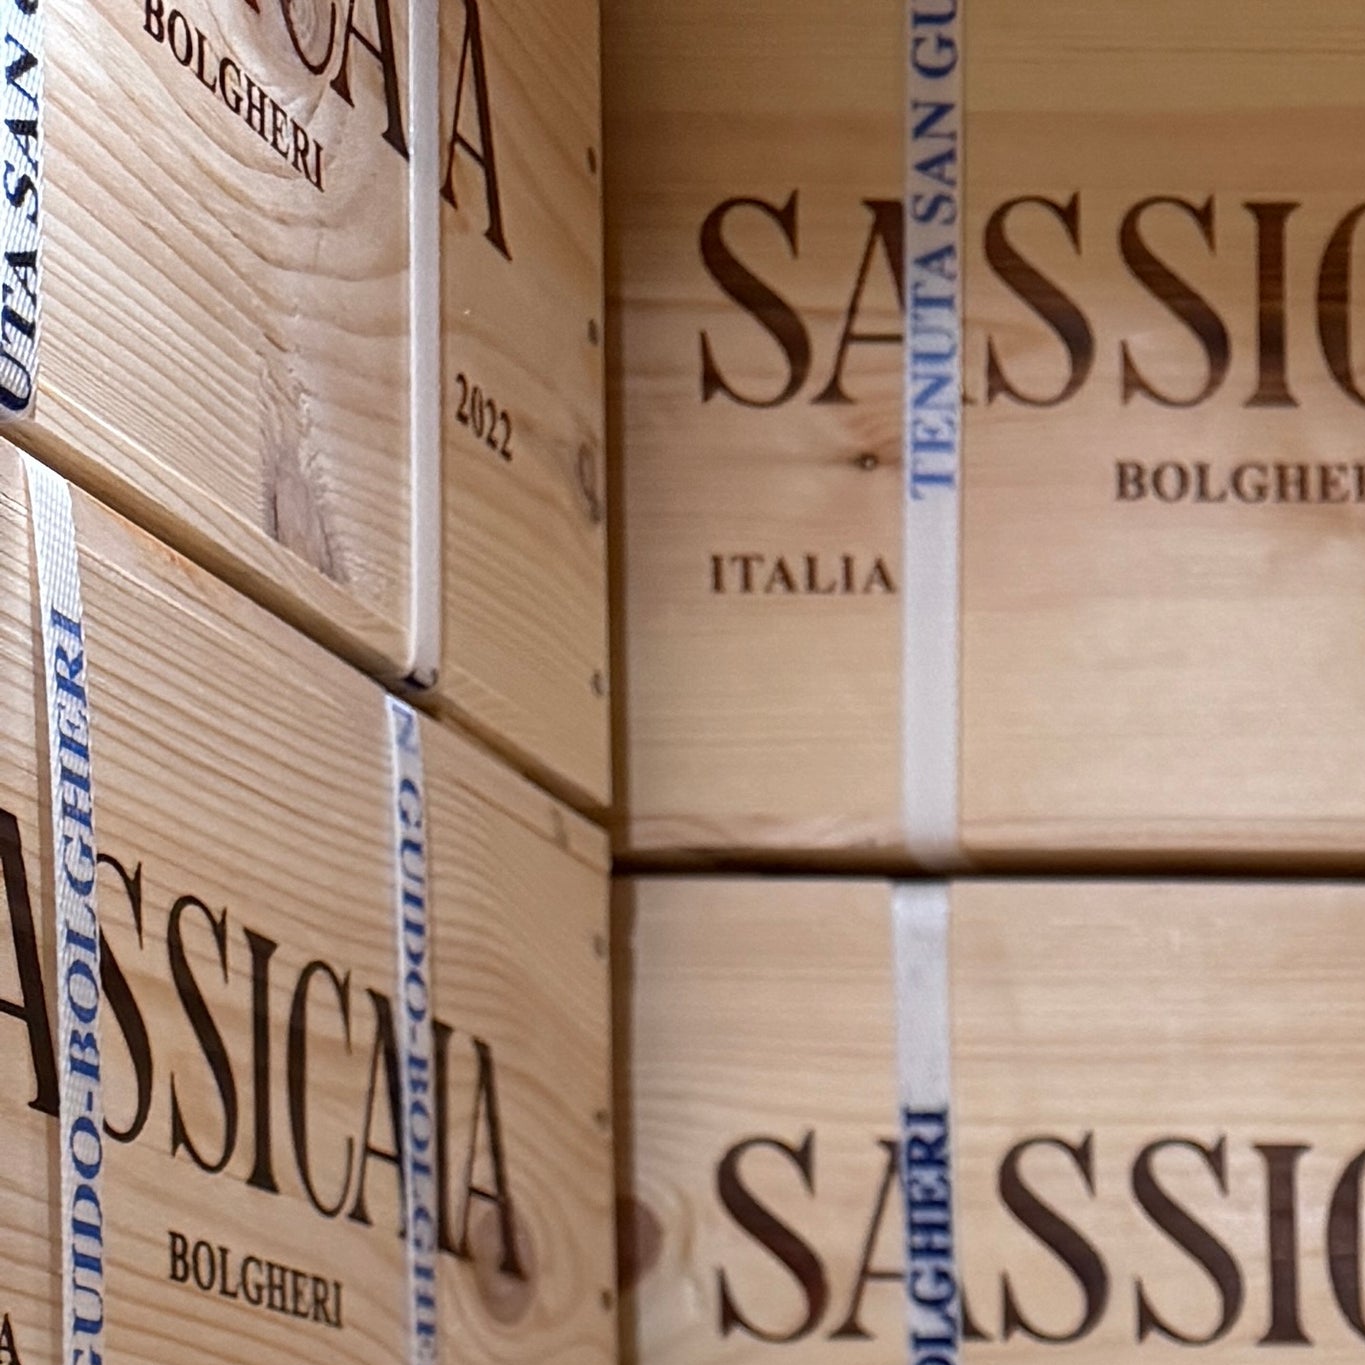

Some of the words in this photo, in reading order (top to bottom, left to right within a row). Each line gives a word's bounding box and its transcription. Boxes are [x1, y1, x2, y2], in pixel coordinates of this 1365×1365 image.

[4, 32, 38, 223] SAN
[143, 0, 324, 192] BOLGHERI
[910, 100, 957, 228] SAN
[454, 372, 514, 462] 2022
[910, 243, 957, 499] TENUTA
[709, 554, 897, 595] ITALIA
[167, 1230, 343, 1330] BOLGHERI
